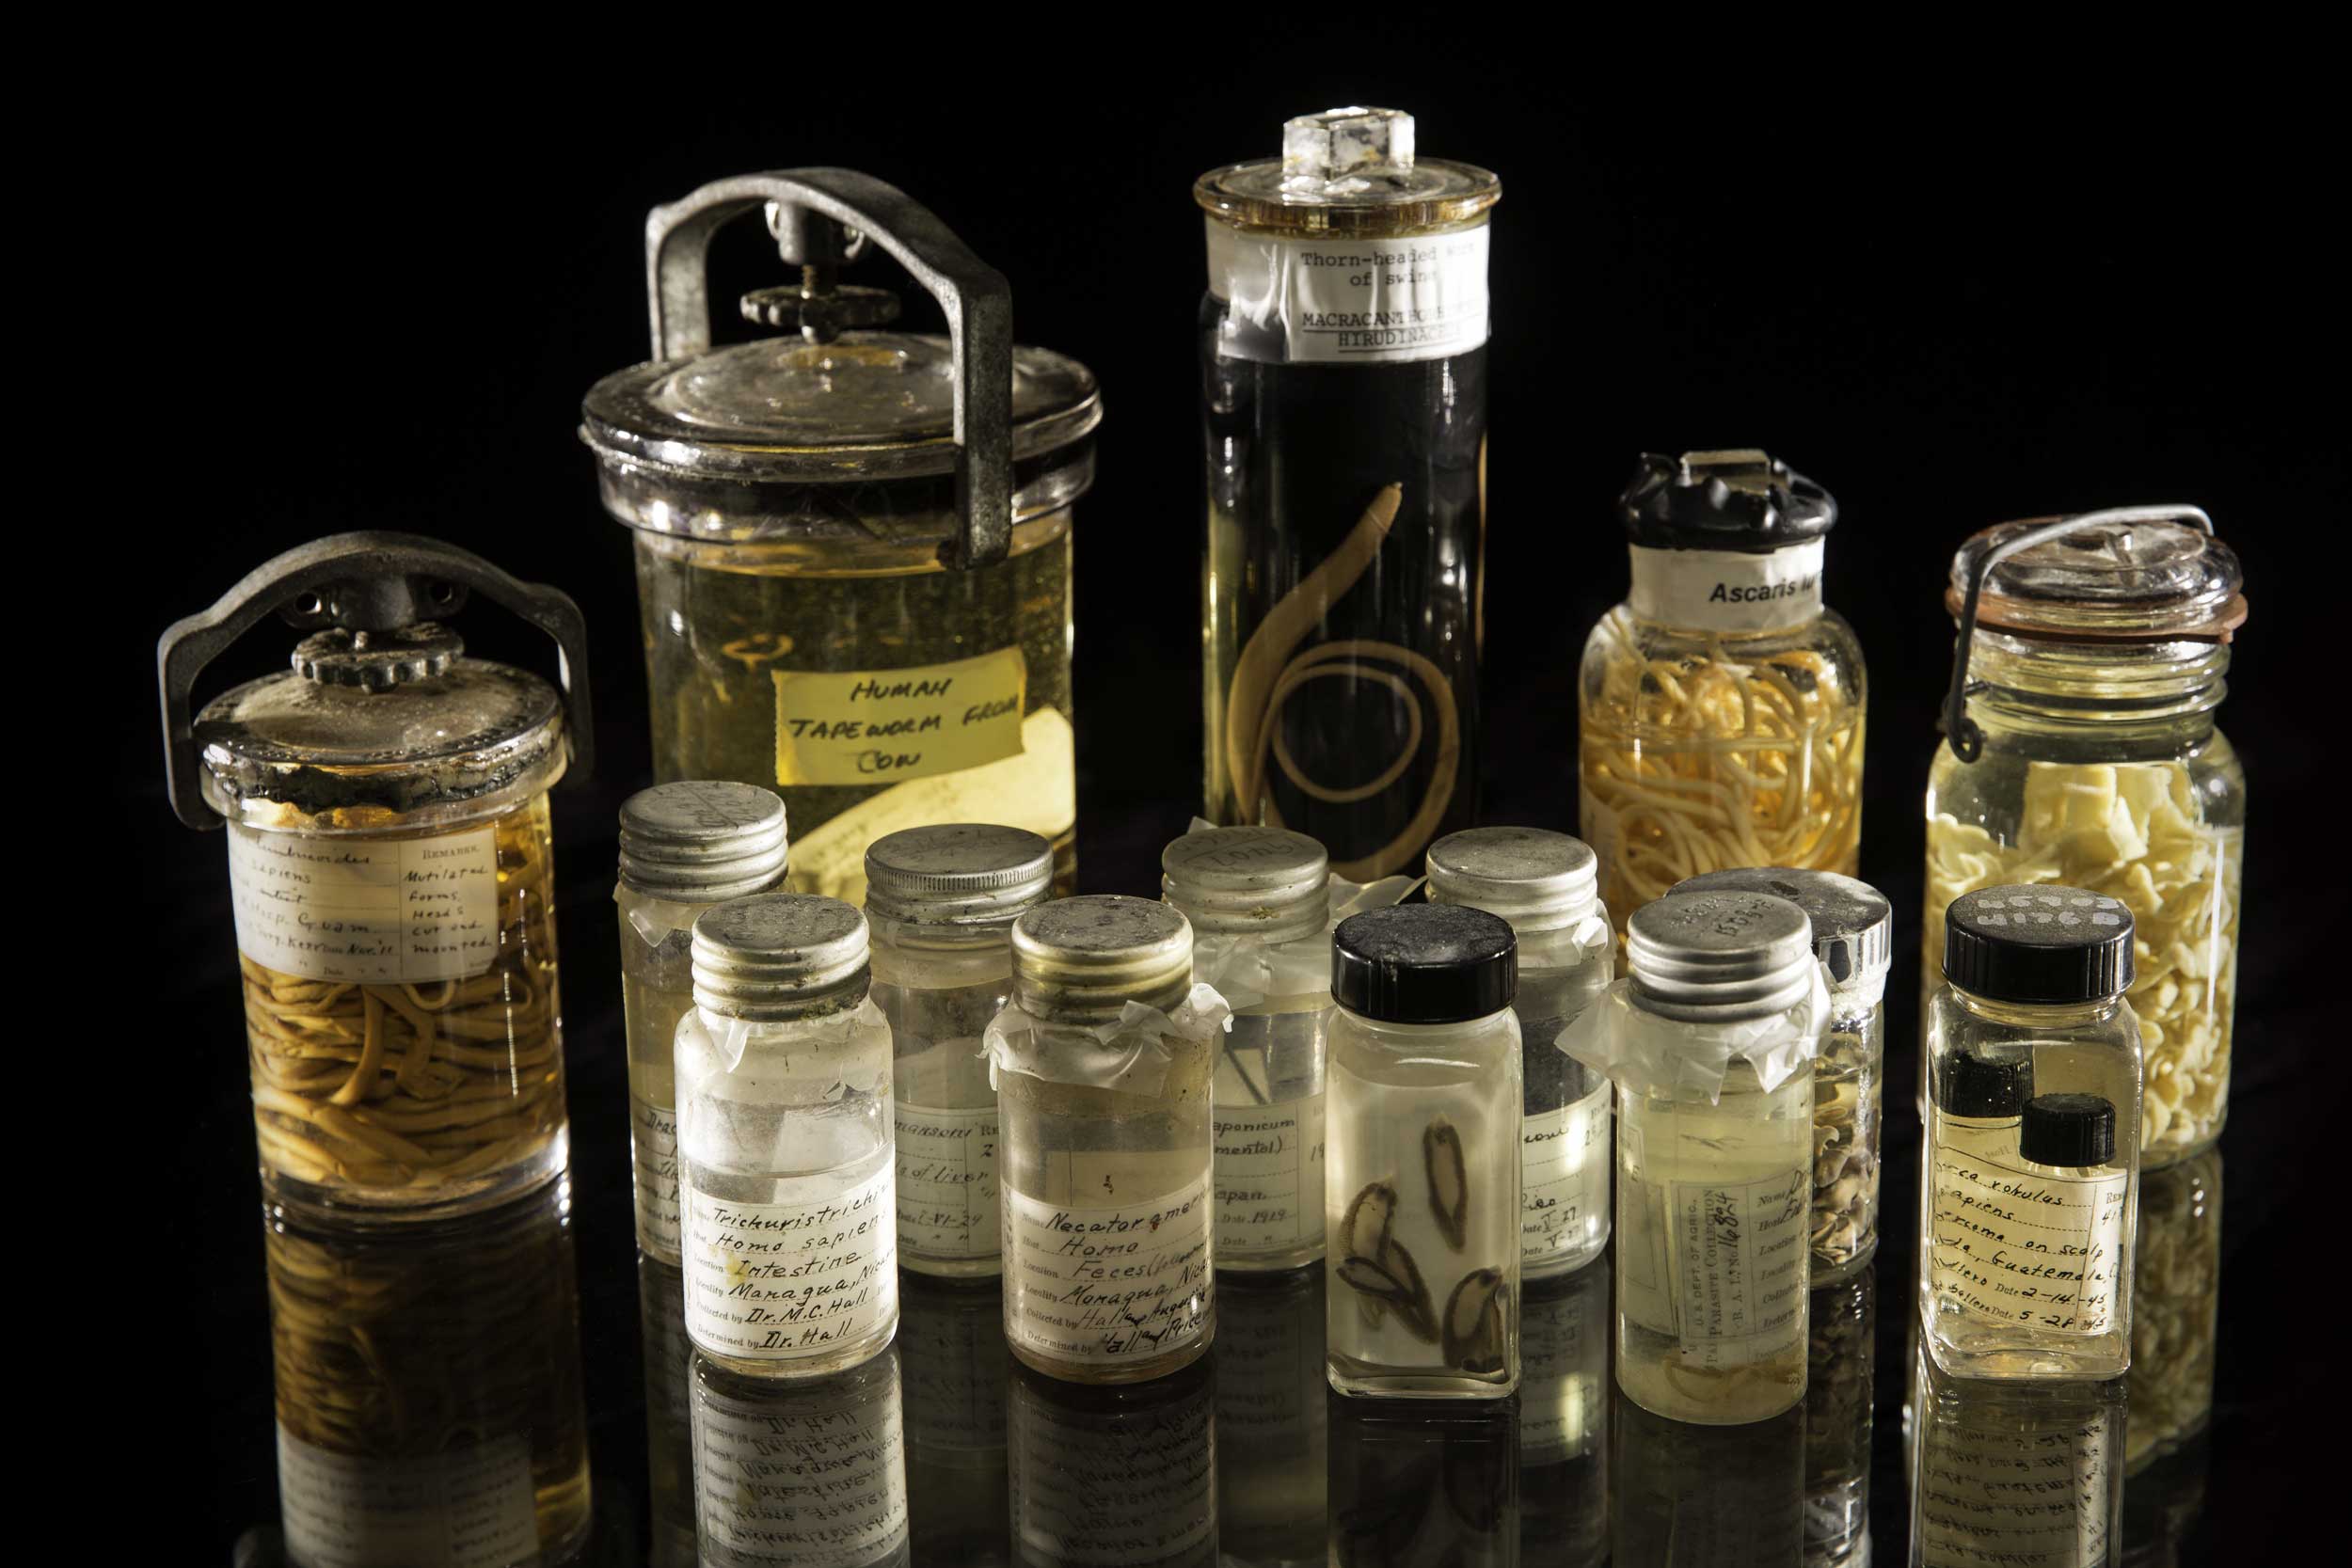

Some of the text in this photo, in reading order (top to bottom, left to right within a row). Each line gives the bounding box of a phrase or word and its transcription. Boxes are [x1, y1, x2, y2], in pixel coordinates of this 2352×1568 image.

[1301, 246, 1438, 268] Thorn-headed
[1350, 273, 1374, 287] of
[1709, 578, 1796, 603] Ascaris
[850, 677, 953, 702] HUMAN
[961, 693, 1019, 726] FROM
[857, 751, 922, 773] COW
[716, 1232, 785, 1252] Homo
[802, 1211, 885, 1249] sapien
[1044, 1210, 1145, 1233] Necator
[1057, 1235, 1139, 1257] Homo
[1689, 1245, 1701, 1261] OF
[2026, 1239, 2048, 1255] on
[733, 1249, 862, 1278] Intestine
[1023, 1259, 1060, 1280] Location
[1072, 1259, 1145, 1280] Feces
[1025, 1282, 1059, 1304] Locality
[1994, 1282, 2019, 1298] Date
[743, 1307, 778, 1324] Dr.
[826, 1287, 869, 1315] Hall
[731, 1313, 743, 1324] by
[1026, 1306, 1079, 1330] Collected by
[1078, 1307, 1126, 1330] Hall
[697, 1323, 759, 1351] Determined by
[758, 1317, 853, 1350] Dr. Hall
[1026, 1329, 1079, 1353] Determined
